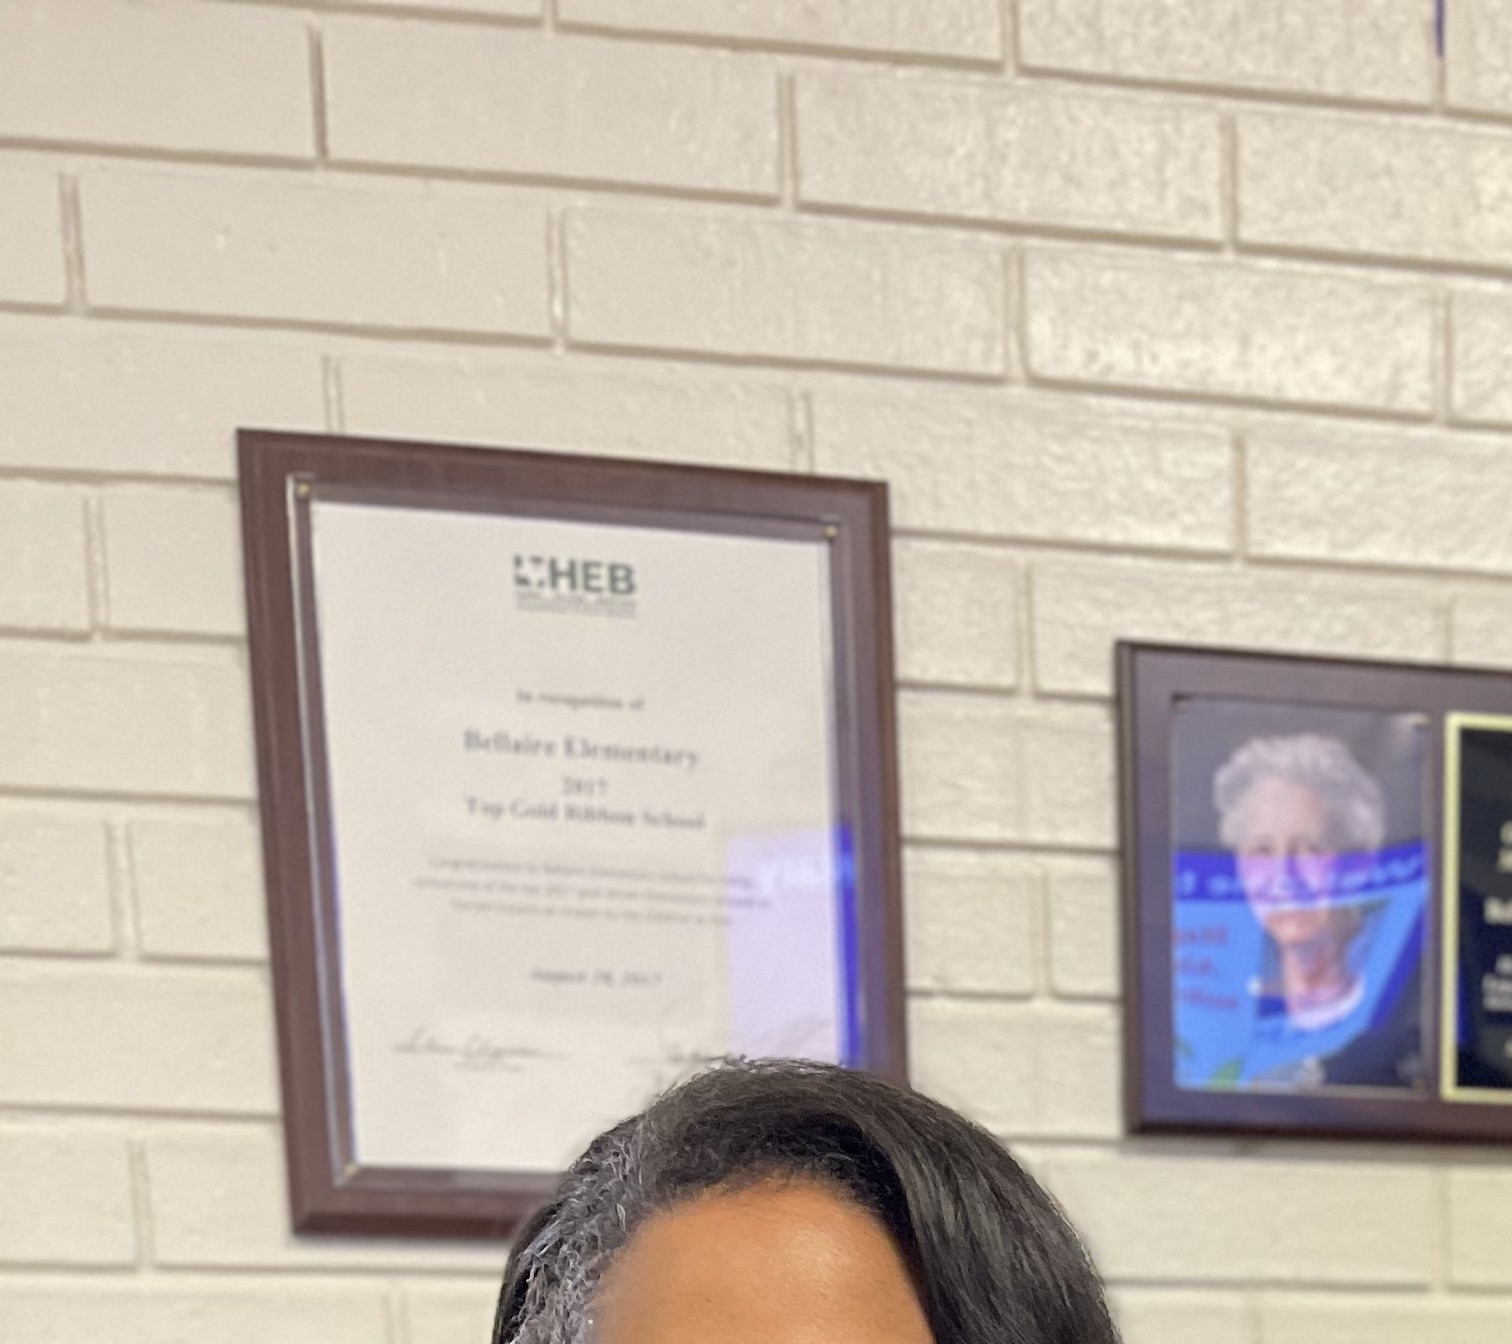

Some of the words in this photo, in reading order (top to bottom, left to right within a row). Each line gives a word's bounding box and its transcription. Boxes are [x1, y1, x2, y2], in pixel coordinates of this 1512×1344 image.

[549, 557, 637, 595] HEB
[463, 728, 556, 757] Bellaire
[563, 736, 699, 773] Elementary
